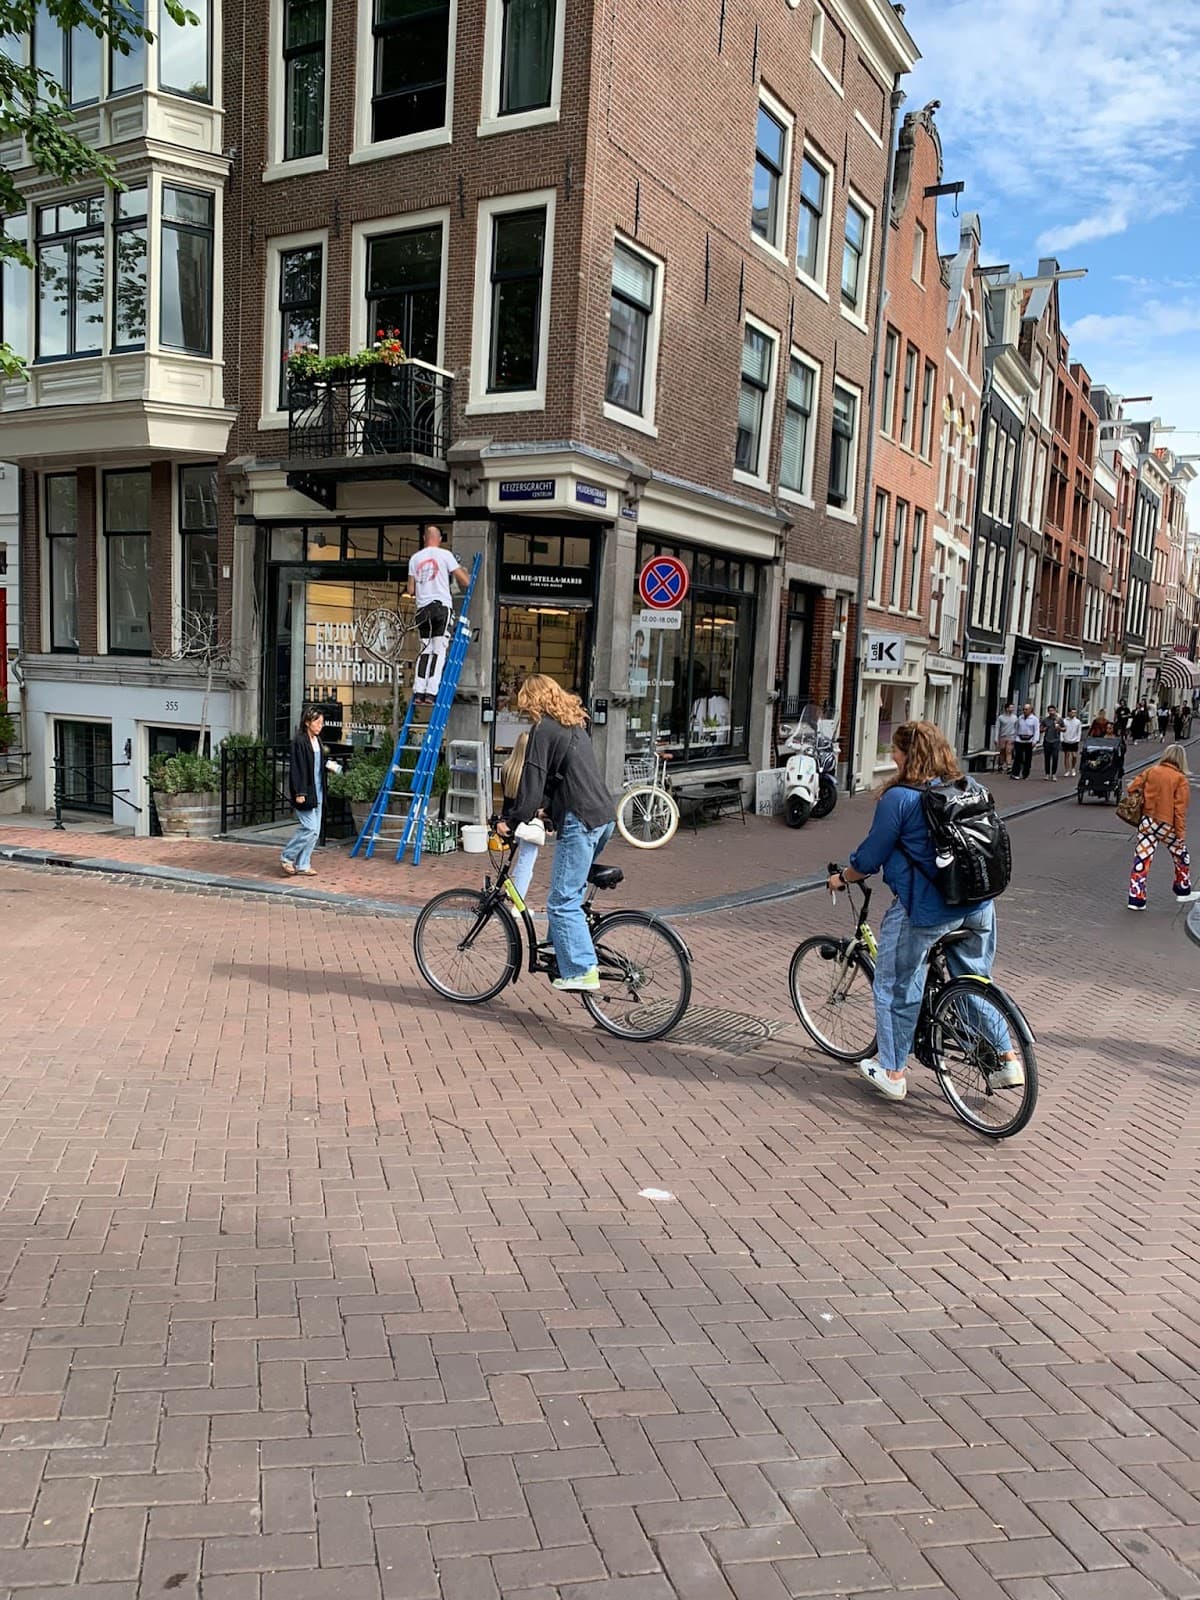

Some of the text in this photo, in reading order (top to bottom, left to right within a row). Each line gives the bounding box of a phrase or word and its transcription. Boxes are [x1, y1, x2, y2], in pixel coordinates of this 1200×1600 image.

[501, 482, 553, 492] KEIZERSGRACHT
[510, 574, 582, 585] MARIE-STELLA-MARIS
[316, 622, 357, 640] ENJOY
[316, 642, 362, 662] REFILL
[879, 642, 897, 661] K
[316, 661, 404, 684] CONTRIBUTE
[165, 700, 178, 711] 355
